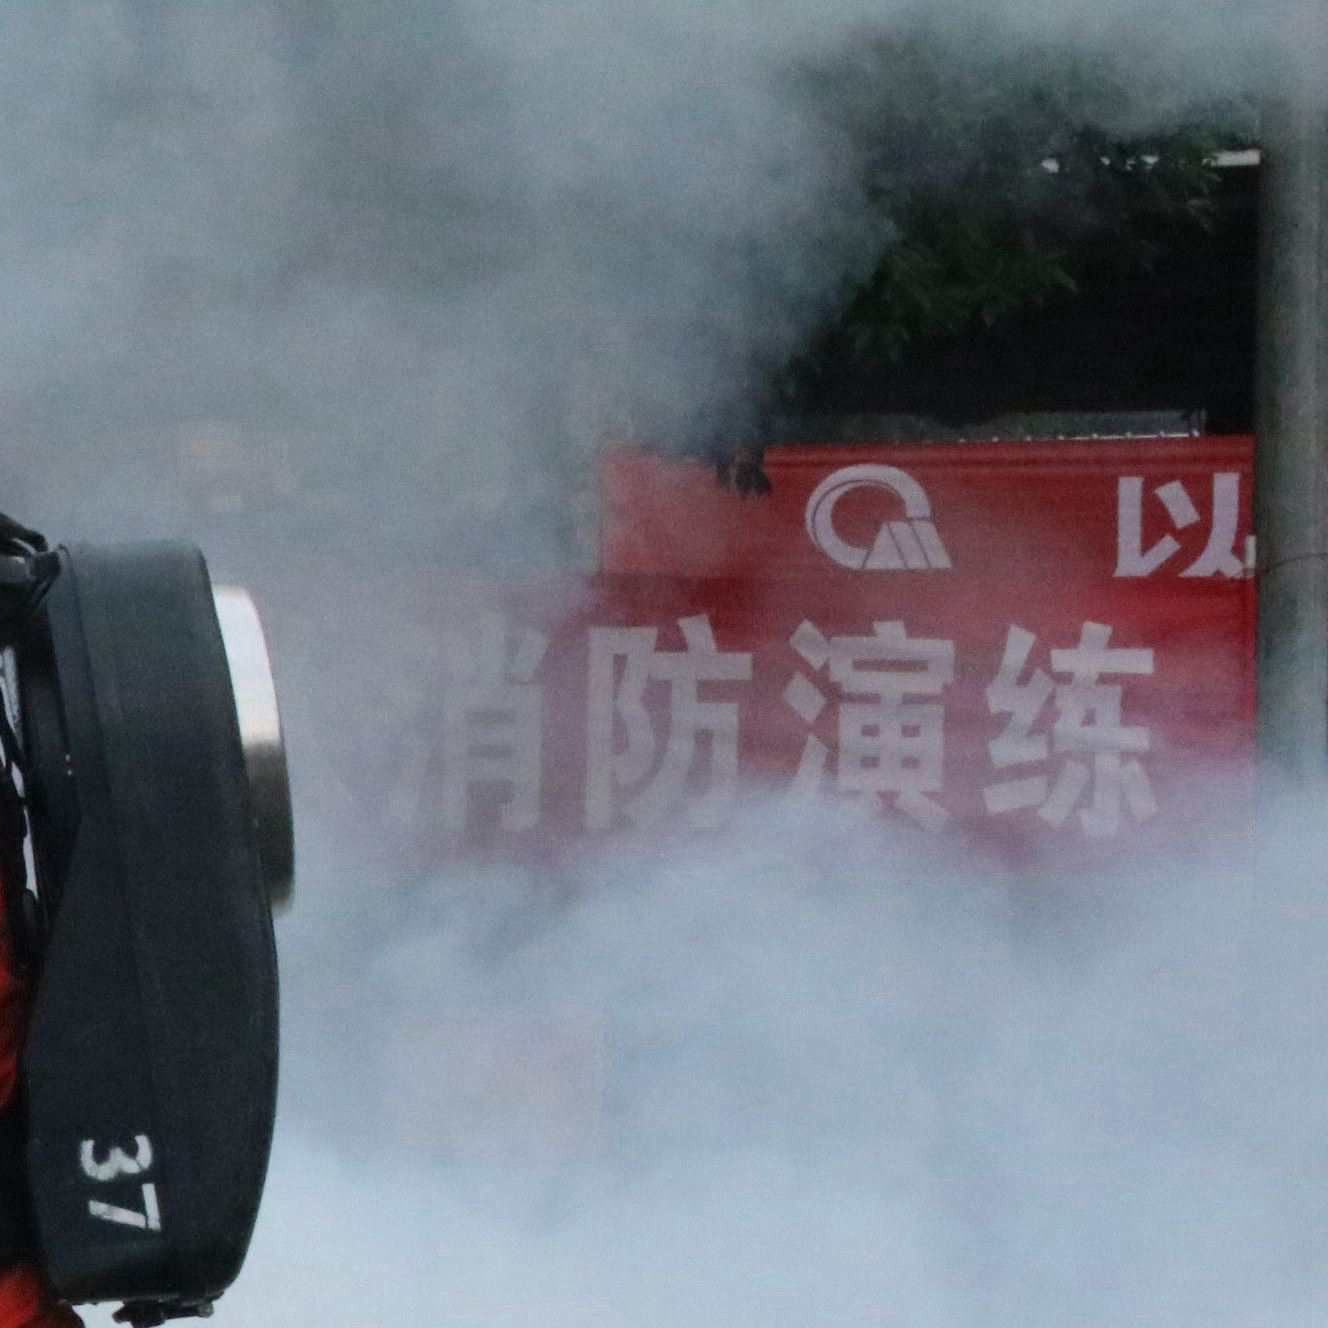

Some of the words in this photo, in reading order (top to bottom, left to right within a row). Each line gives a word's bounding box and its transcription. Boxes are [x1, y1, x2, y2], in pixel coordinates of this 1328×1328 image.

[389, 613, 1159, 837] 消防演练
[80, 1134, 161, 1231] 37
